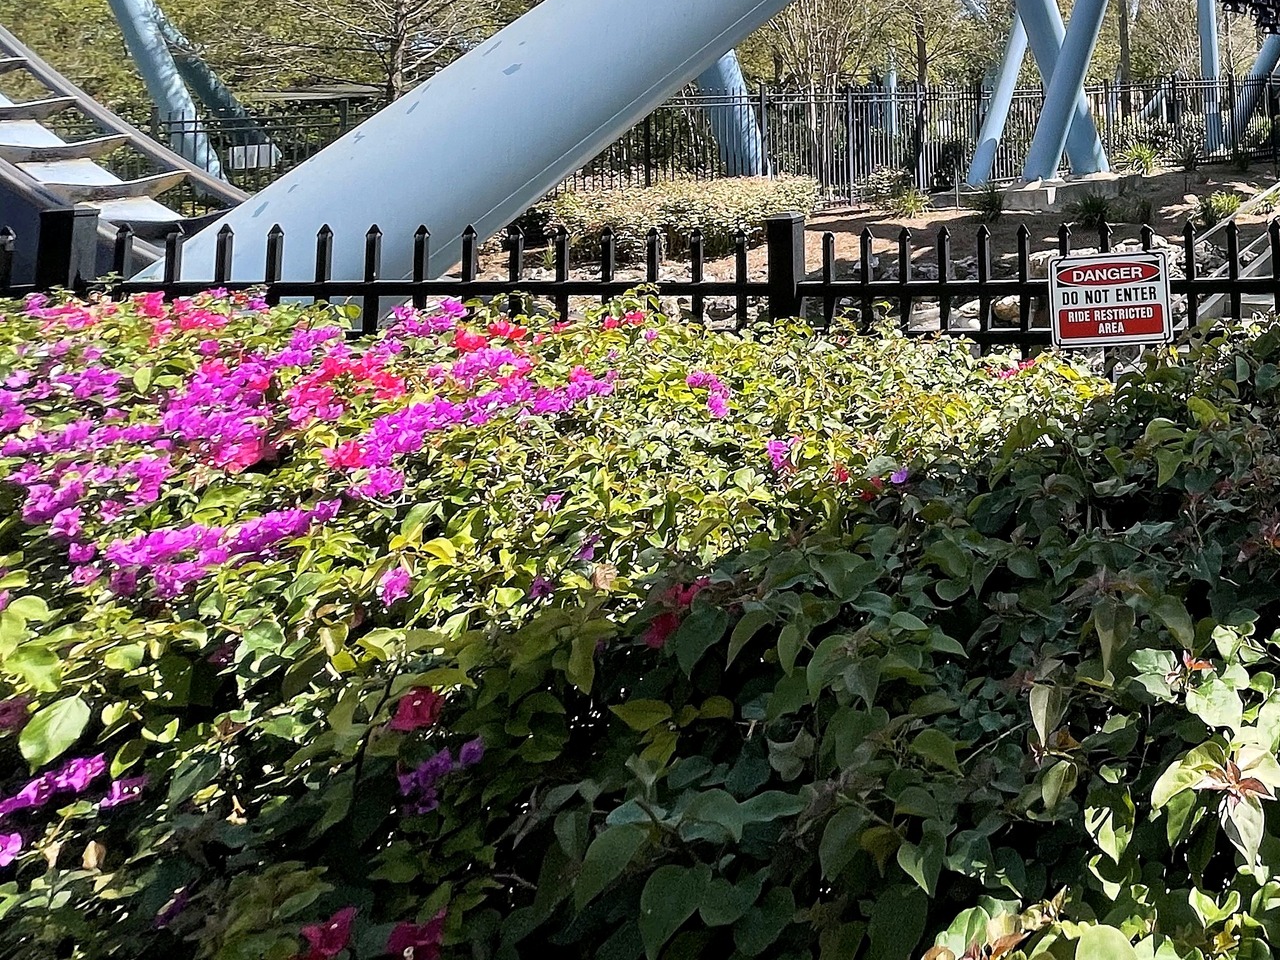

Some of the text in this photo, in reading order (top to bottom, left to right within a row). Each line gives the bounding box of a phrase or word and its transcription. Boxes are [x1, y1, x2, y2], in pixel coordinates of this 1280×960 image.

[1072, 267, 1142, 282] DANGER
[1062, 286, 1156, 305] DO NOT ENTER
[1068, 307, 1153, 322] RIDE RESTRICTED
[1098, 322, 1124, 334] AREA
